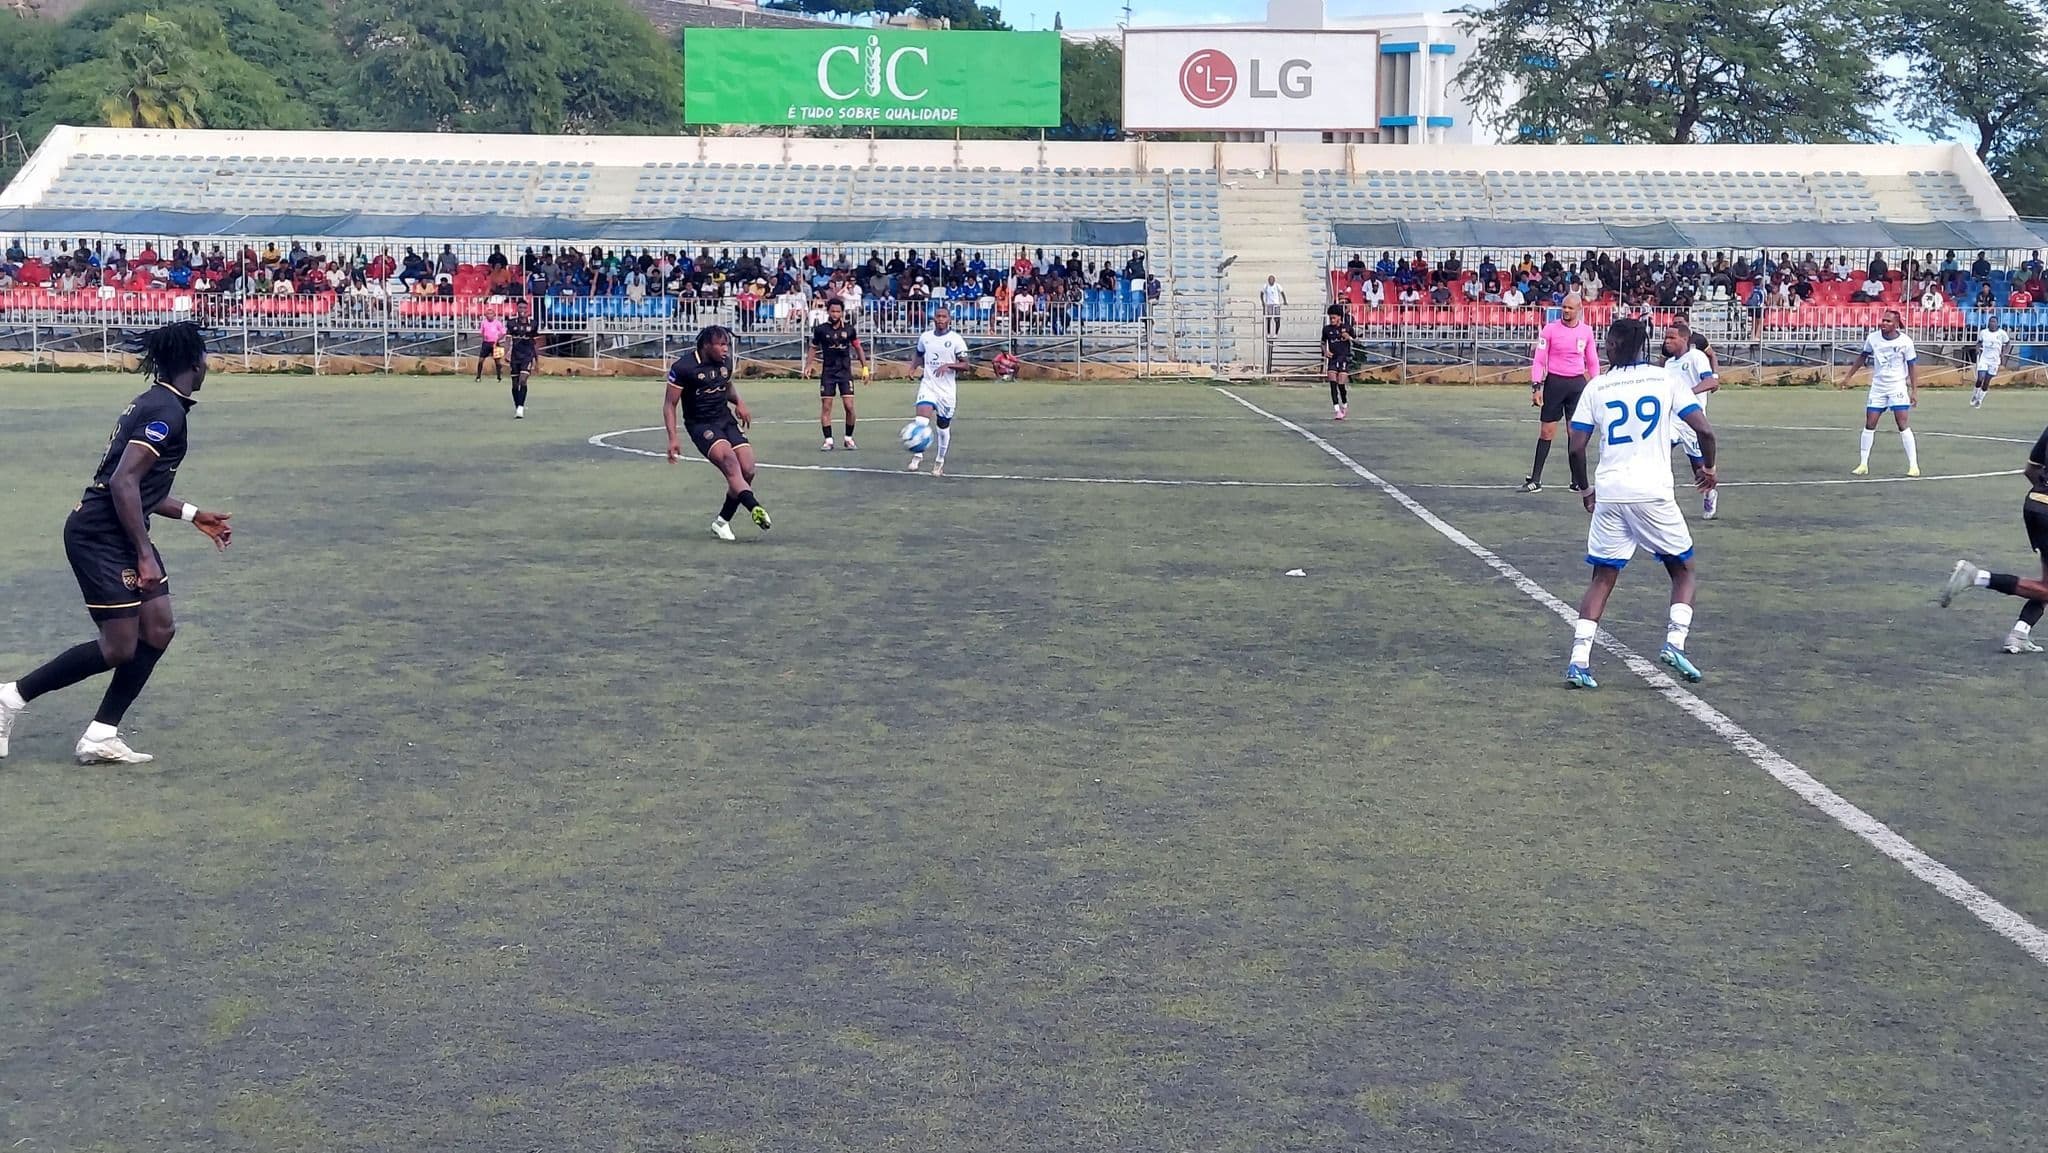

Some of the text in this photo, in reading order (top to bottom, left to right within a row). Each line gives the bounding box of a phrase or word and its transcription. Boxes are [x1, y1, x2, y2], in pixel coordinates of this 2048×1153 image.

[1249, 58, 1313, 99] LG
[787, 104, 959, 121] É TUDO SOBRE QUALIDADE
[1604, 394, 1662, 446] 29
